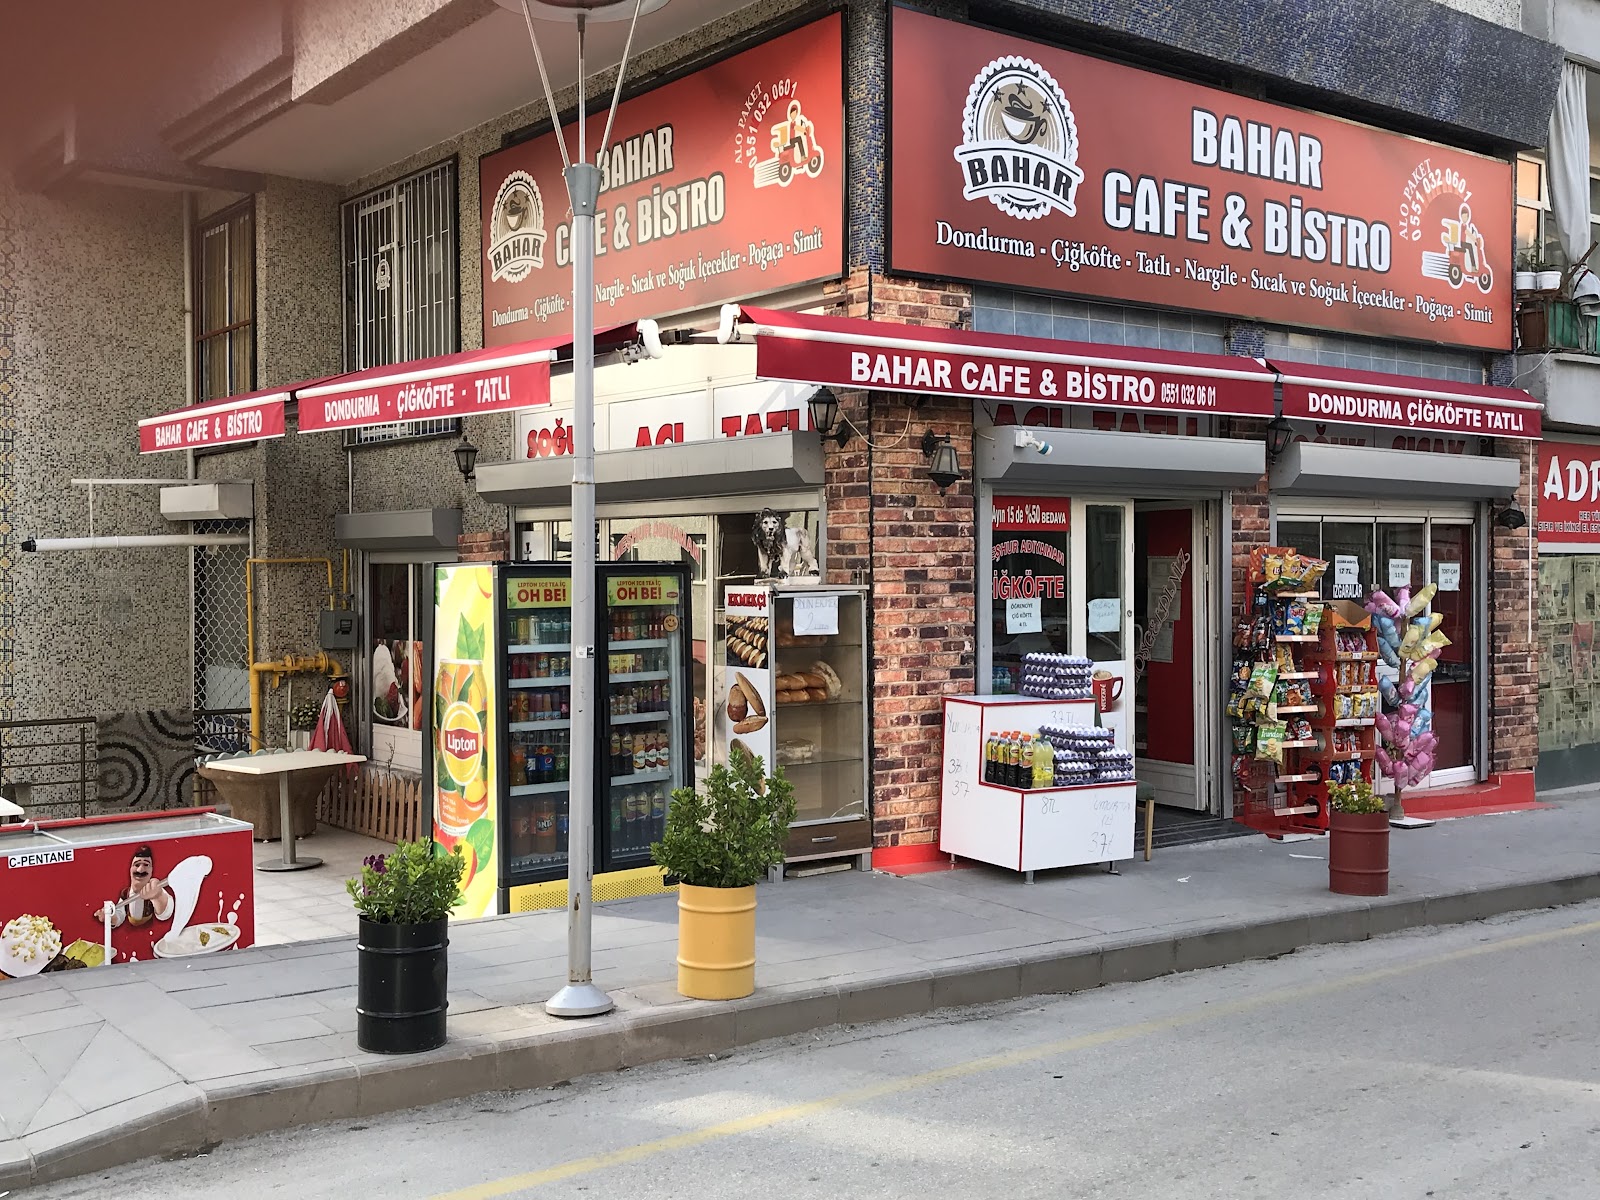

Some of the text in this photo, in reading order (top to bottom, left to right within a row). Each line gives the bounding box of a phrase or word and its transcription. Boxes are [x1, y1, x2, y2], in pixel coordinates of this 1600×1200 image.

[734, 80, 763, 164] ALO PAKET
[745, 78, 798, 169] 0551 032 0601
[599, 126, 674, 193] BAHAR
[1192, 109, 1323, 189] BAHAR
[967, 155, 1073, 201] BAHAR
[1398, 158, 1432, 241] ALO PAKET
[555, 173, 725, 266] CE & BİSTRO
[1103, 170, 1392, 273] CAFE & BİSTRO
[1409, 167, 1473, 242] 0551 032 0601
[493, 237, 541, 272] BAHAR
[595, 278, 625, 307] Nargile
[631, 269, 655, 294] Sıcak
[656, 273, 666, 288] ve
[668, 259, 696, 291] Soğuk
[698, 251, 740, 283] İçecekler
[748, 240, 784, 271] Poğaça
[793, 226, 823, 255] Simit
[936, 220, 1493, 325] Dondurma Çiğköfte Tatlı Nargile Sıcak ve Soğuk İçecekler Poğaça Simit
[492, 306, 529, 328] Dondurma
[534, 293, 566, 322] Çiğköfte
[324, 375, 512, 424] DONDURMA ÇİĞKÖFTE TATLI
[850, 351, 1217, 408] BAHAR CAFE & BİSTRO 0551 032 06 01
[155, 409, 263, 448] BAHAR CAFE & BİSTRO
[1308, 391, 1523, 432] DONDURMA ÇİĞKÖFTE TATLI
[1007, 505, 1015, 524] 15
[1015, 505, 1024, 524] de
[1024, 504, 1040, 524] %50
[1041, 511, 1067, 524] BEDAVA
[517, 588, 567, 603] OH BE!
[616, 587, 638, 601] OH
[640, 586, 662, 600] BE!
[992, 568, 1065, 600] İĞKÖFTE
[447, 733, 476, 753] Lipton
[8, 850, 73, 868] C-PENTANE
